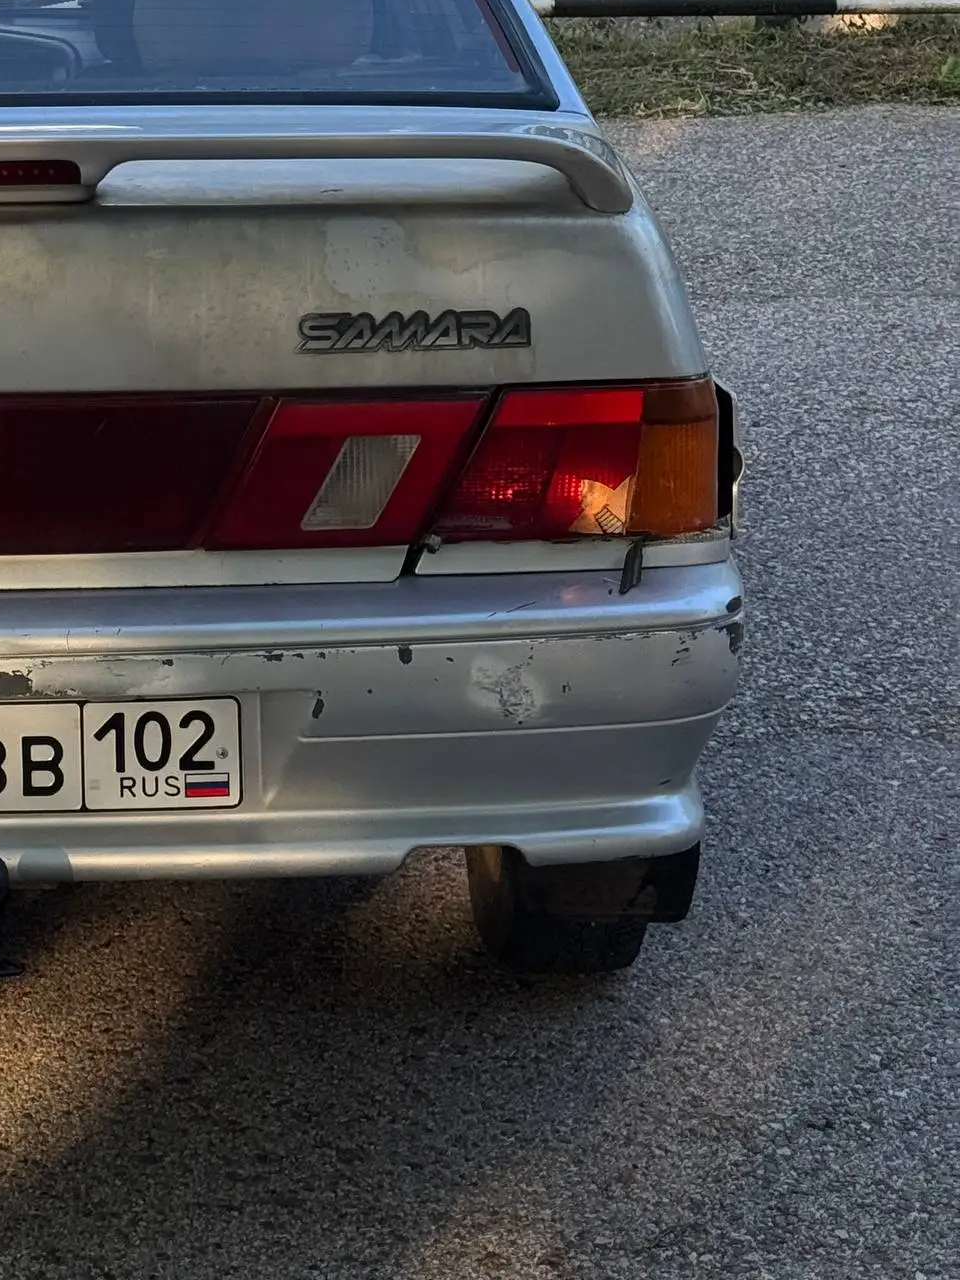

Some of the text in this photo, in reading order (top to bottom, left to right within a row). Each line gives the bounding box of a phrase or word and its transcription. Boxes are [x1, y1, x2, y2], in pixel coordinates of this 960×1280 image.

[296, 307, 531, 354] SAMARA
[93, 710, 217, 774] 102
[120, 775, 181, 799] RUS
